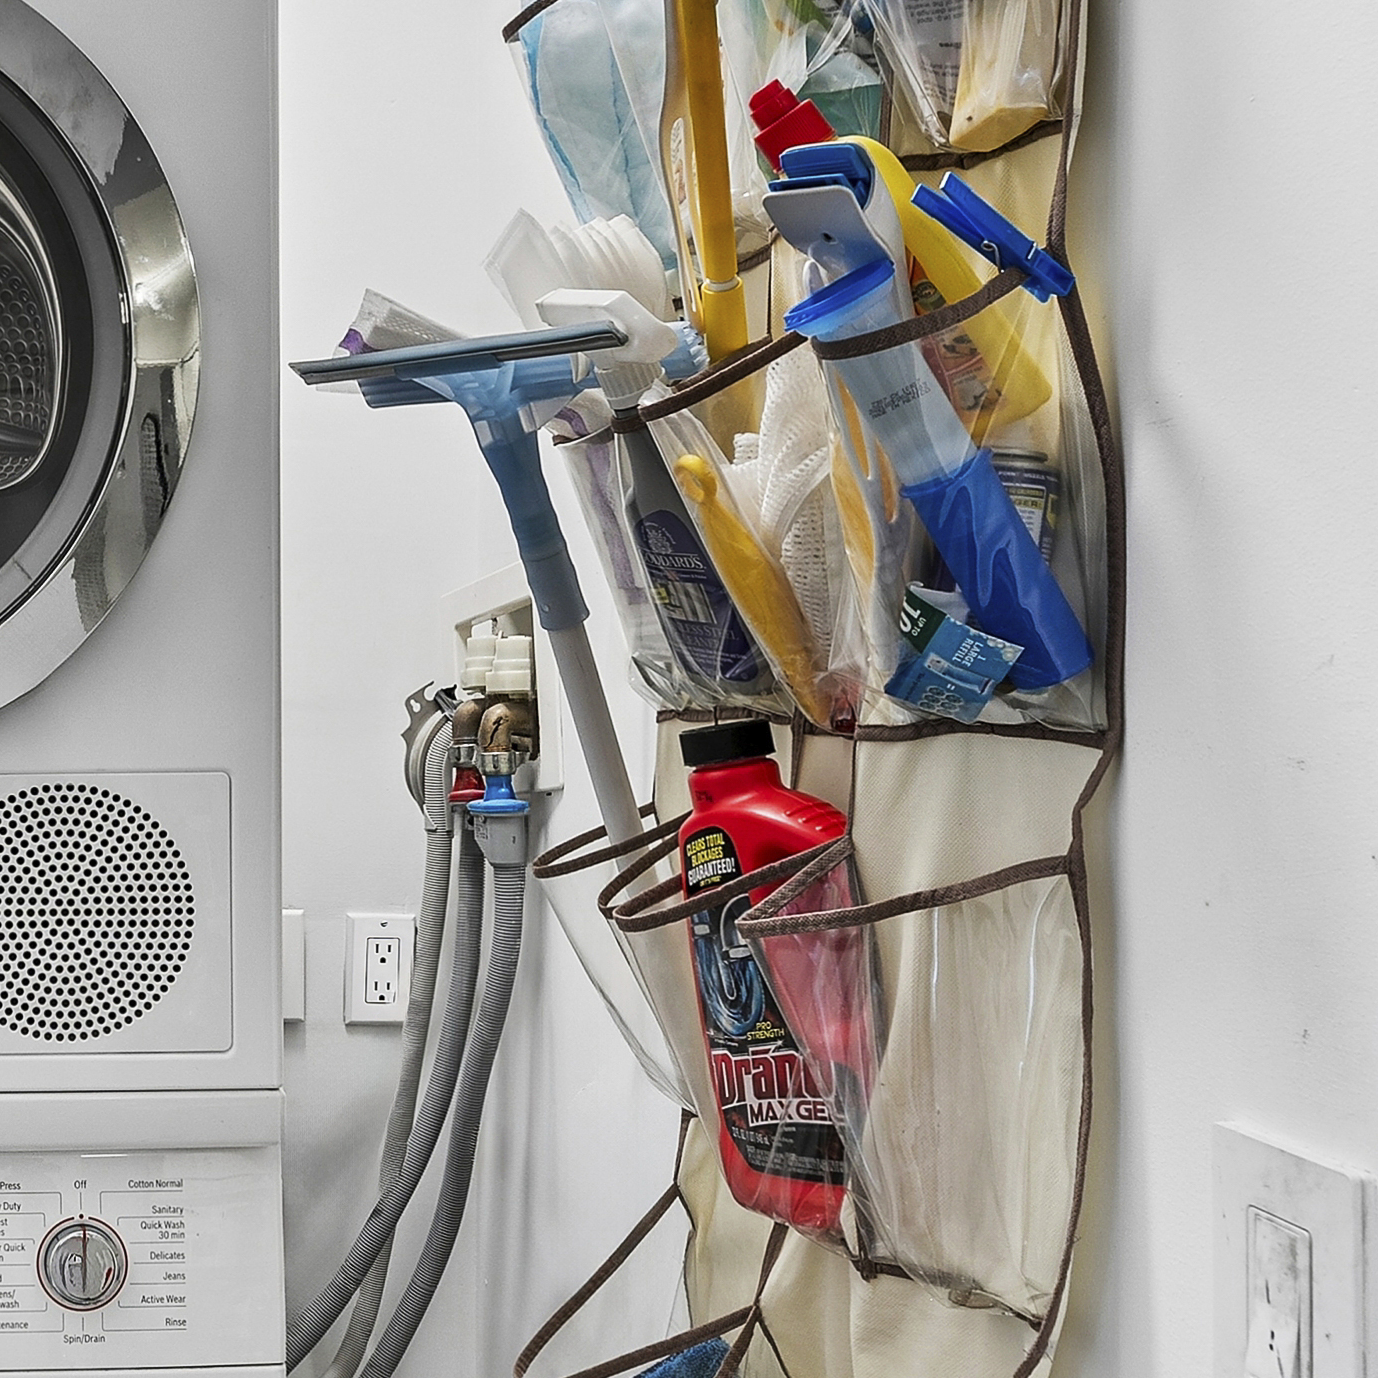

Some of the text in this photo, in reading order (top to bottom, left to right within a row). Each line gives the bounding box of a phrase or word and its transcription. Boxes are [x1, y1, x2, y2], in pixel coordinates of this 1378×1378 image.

[911, 617, 927, 637] UP TO
[952, 638, 974, 663] REFILL
[962, 642, 984, 668] LARGE
[705, 833, 725, 848] TOTAL
[691, 846, 723, 867] BLOCKAGES
[688, 857, 736, 886] GUARANTEED!
[755, 1021, 772, 1031] PRO
[747, 1028, 785, 1041] STRENGTH
[750, 1100, 794, 1124] MAX
[0, 1181, 21, 1190] Press
[74, 1180, 87, 1189] Off
[128, 1179, 183, 1188] Cotton Normal
[3, 1202, 21, 1211] Duty
[152, 1205, 184, 1215] Sanitary
[140, 1220, 185, 1230] Quick Wash
[158, 1230, 185, 1239] 30 min
[3, 1243, 26, 1252] Quick
[150, 1251, 185, 1260] Delicates
[162, 1272, 186, 1281] Jeans
[140, 1295, 186, 1304] Active Wear
[165, 1318, 187, 1326] Rinse
[63, 1334, 106, 1344] Spin/Drain
